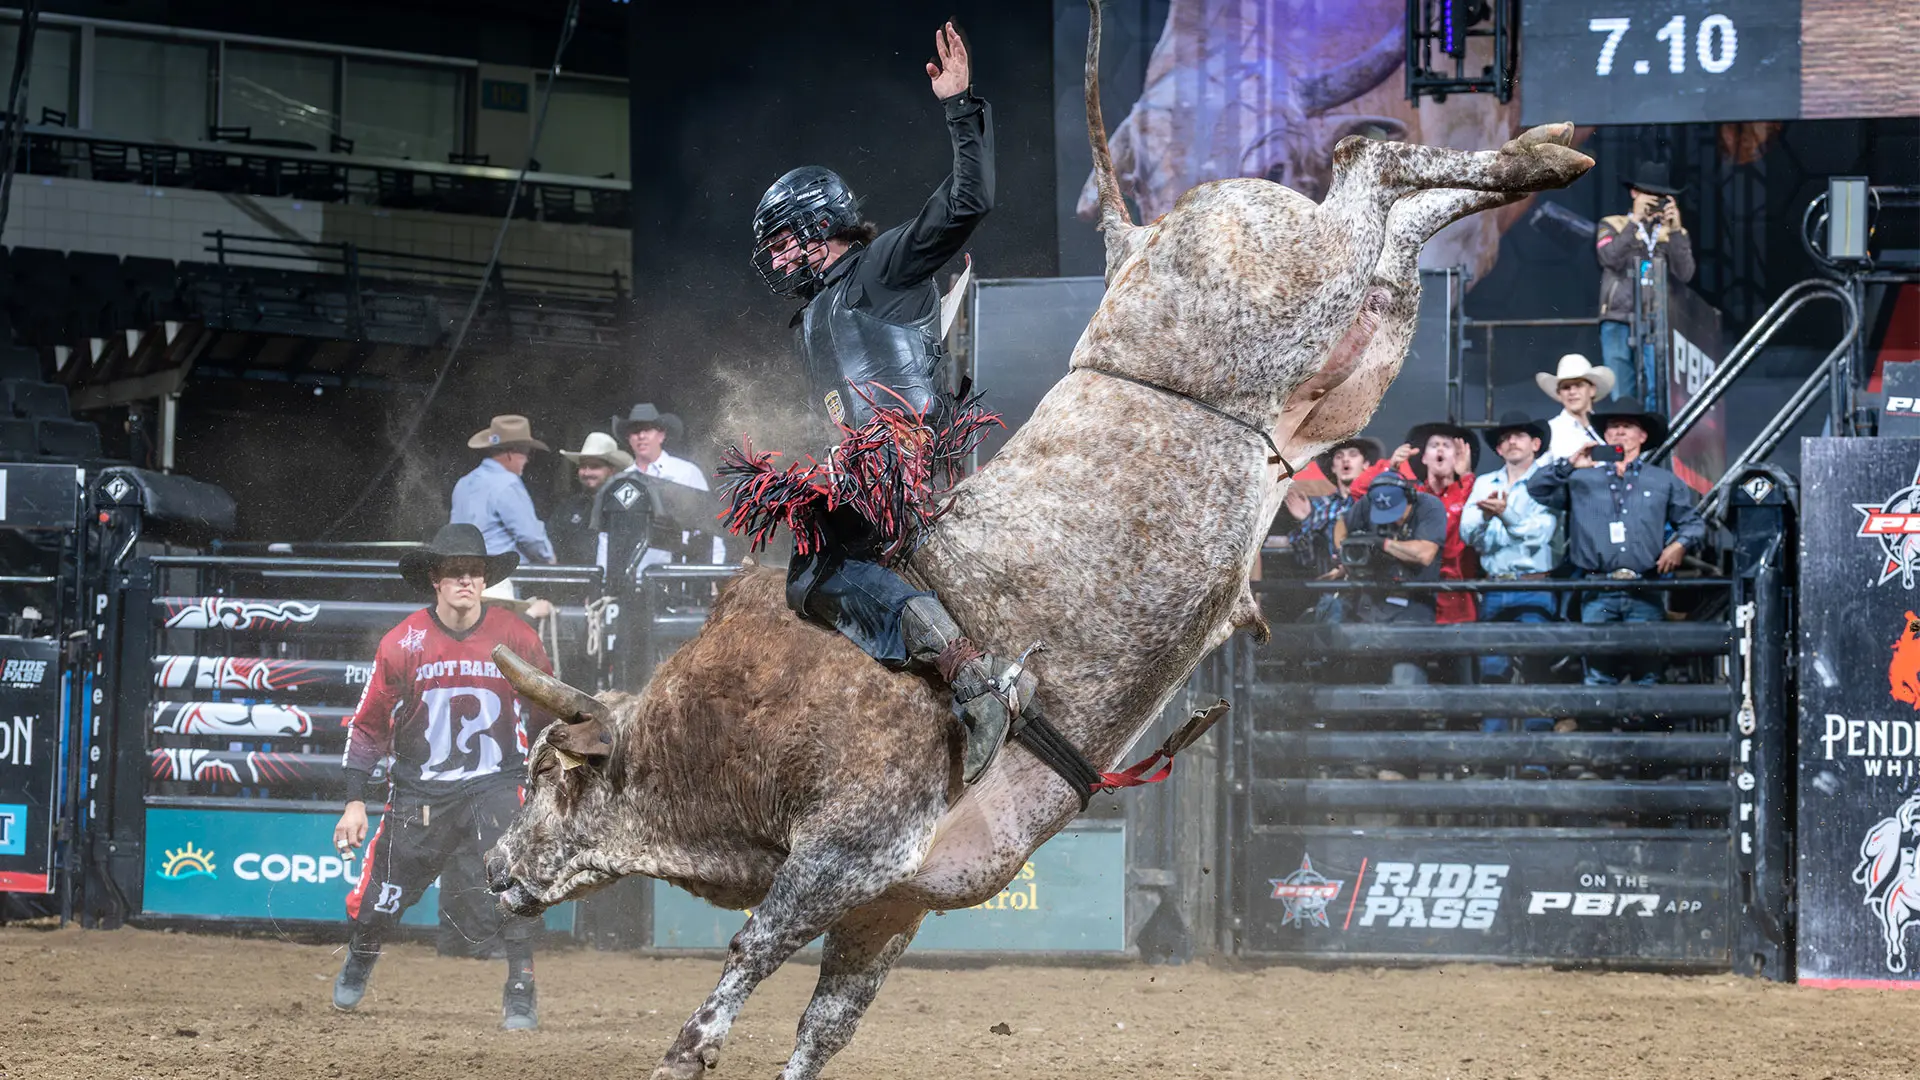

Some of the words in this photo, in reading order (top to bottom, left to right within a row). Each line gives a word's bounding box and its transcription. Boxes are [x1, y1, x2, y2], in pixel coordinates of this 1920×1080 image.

[1589, 14, 1738, 75] 7.10
[1886, 396, 1920, 412] P
[460, 660, 506, 679] BAR
[90, 593, 109, 819] Priefert
[1864, 759, 1920, 777] WHI
[1368, 862, 1510, 898] RIDE
[1580, 873, 1606, 887] ON
[1614, 875, 1649, 888] THE
[1358, 896, 1500, 929] PASS
[1527, 891, 1660, 917] PBR
[1664, 900, 1703, 914] APP
